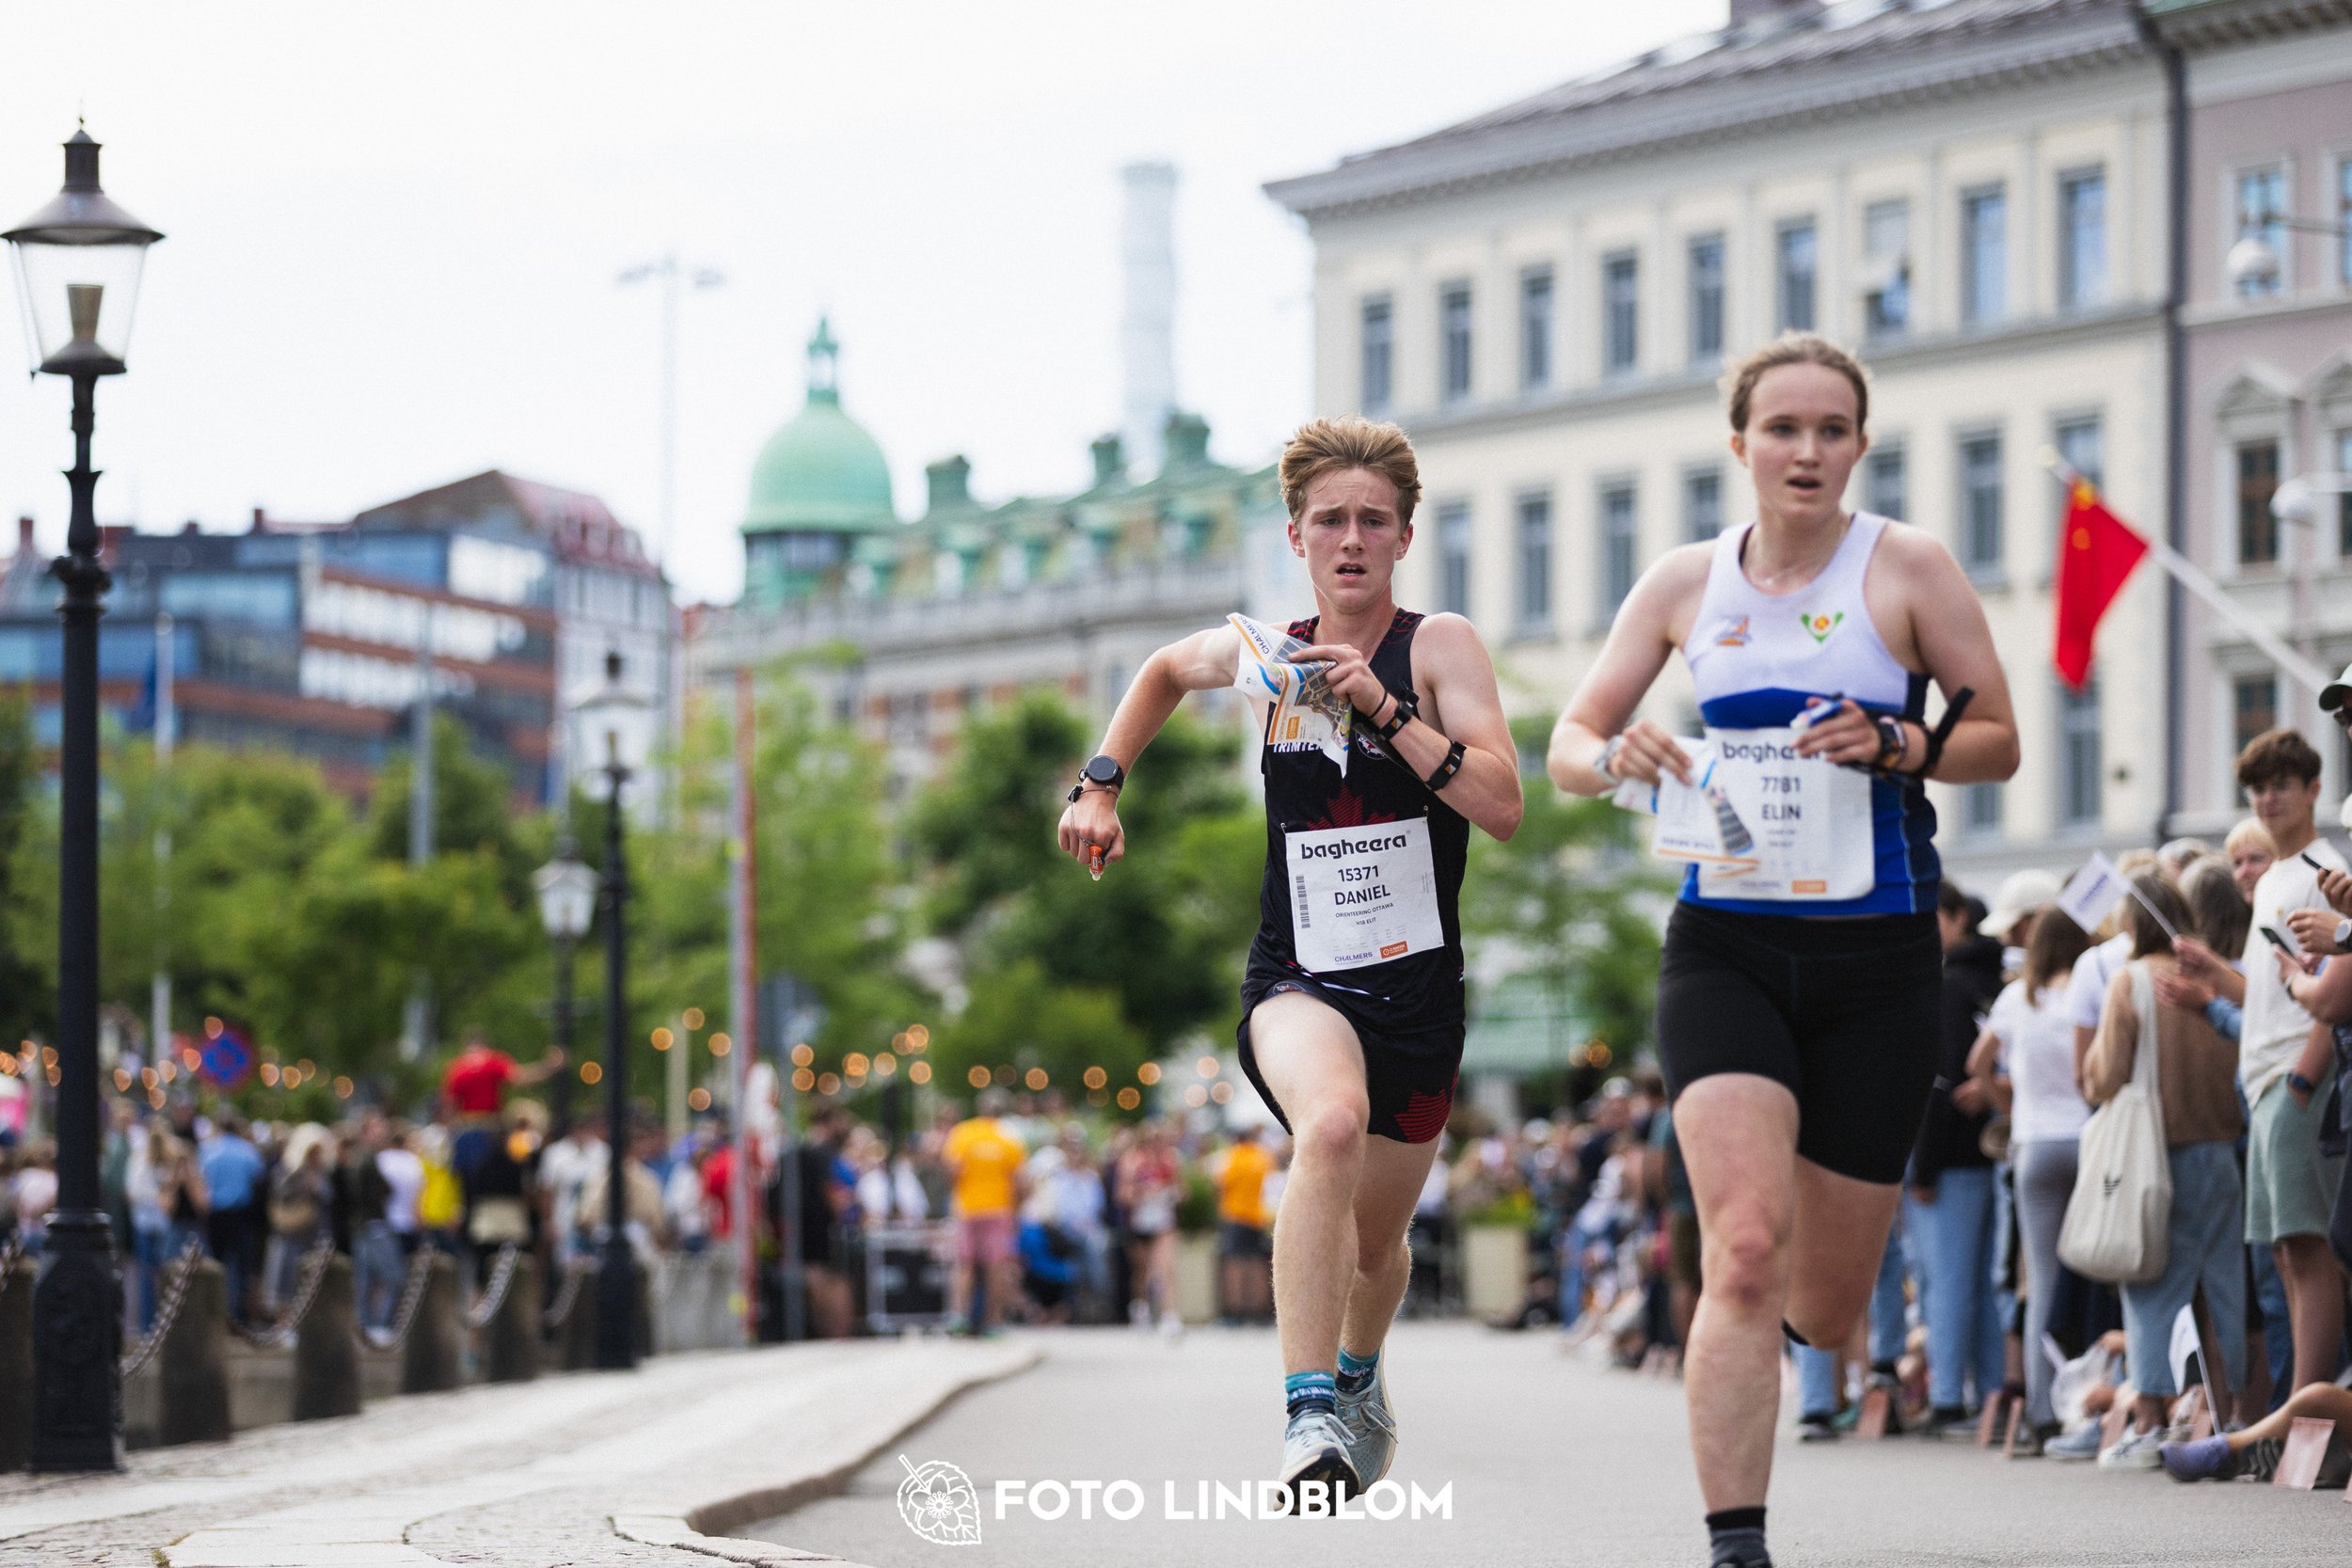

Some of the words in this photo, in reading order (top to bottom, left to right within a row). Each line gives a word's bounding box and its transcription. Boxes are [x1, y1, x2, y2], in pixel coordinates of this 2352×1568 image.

[1761, 777, 1801, 792] 7781
[1761, 804, 1801, 820] ELIN
[1301, 834, 1406, 859] bagheera
[1338, 865, 1379, 882] 15371
[1334, 884, 1391, 905] DANIEL
[1372, 903, 1393, 912] OTTAWA
[1334, 952, 1373, 962] CHALMERS
